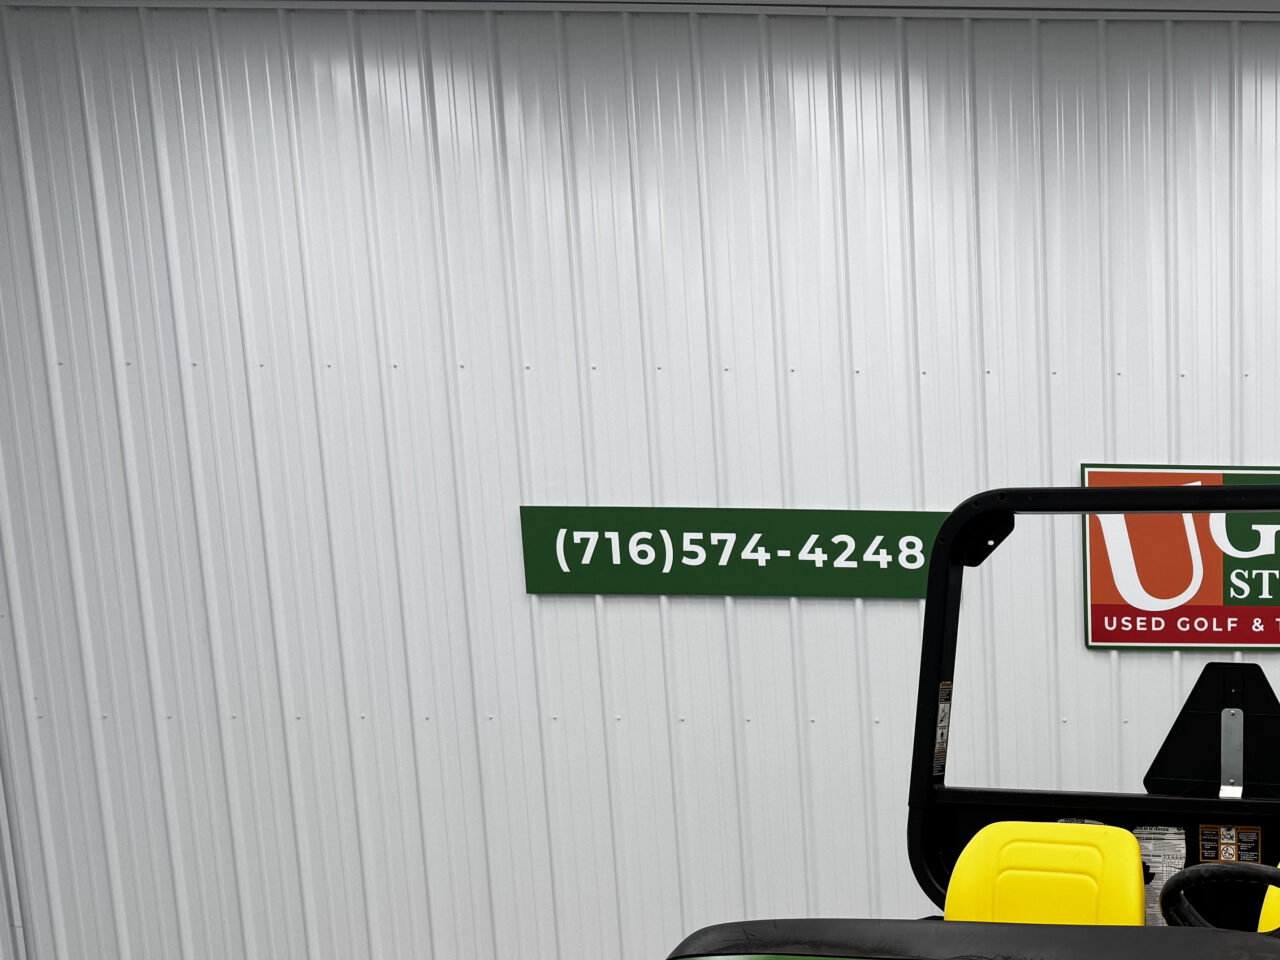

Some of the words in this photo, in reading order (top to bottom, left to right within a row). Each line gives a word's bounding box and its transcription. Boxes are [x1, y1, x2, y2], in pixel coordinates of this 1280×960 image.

[555, 528, 926, 573] (716)574-4248
[1104, 616, 1166, 632] USED
[1177, 616, 1238, 633] GOLF
[1251, 617, 1265, 633] &
